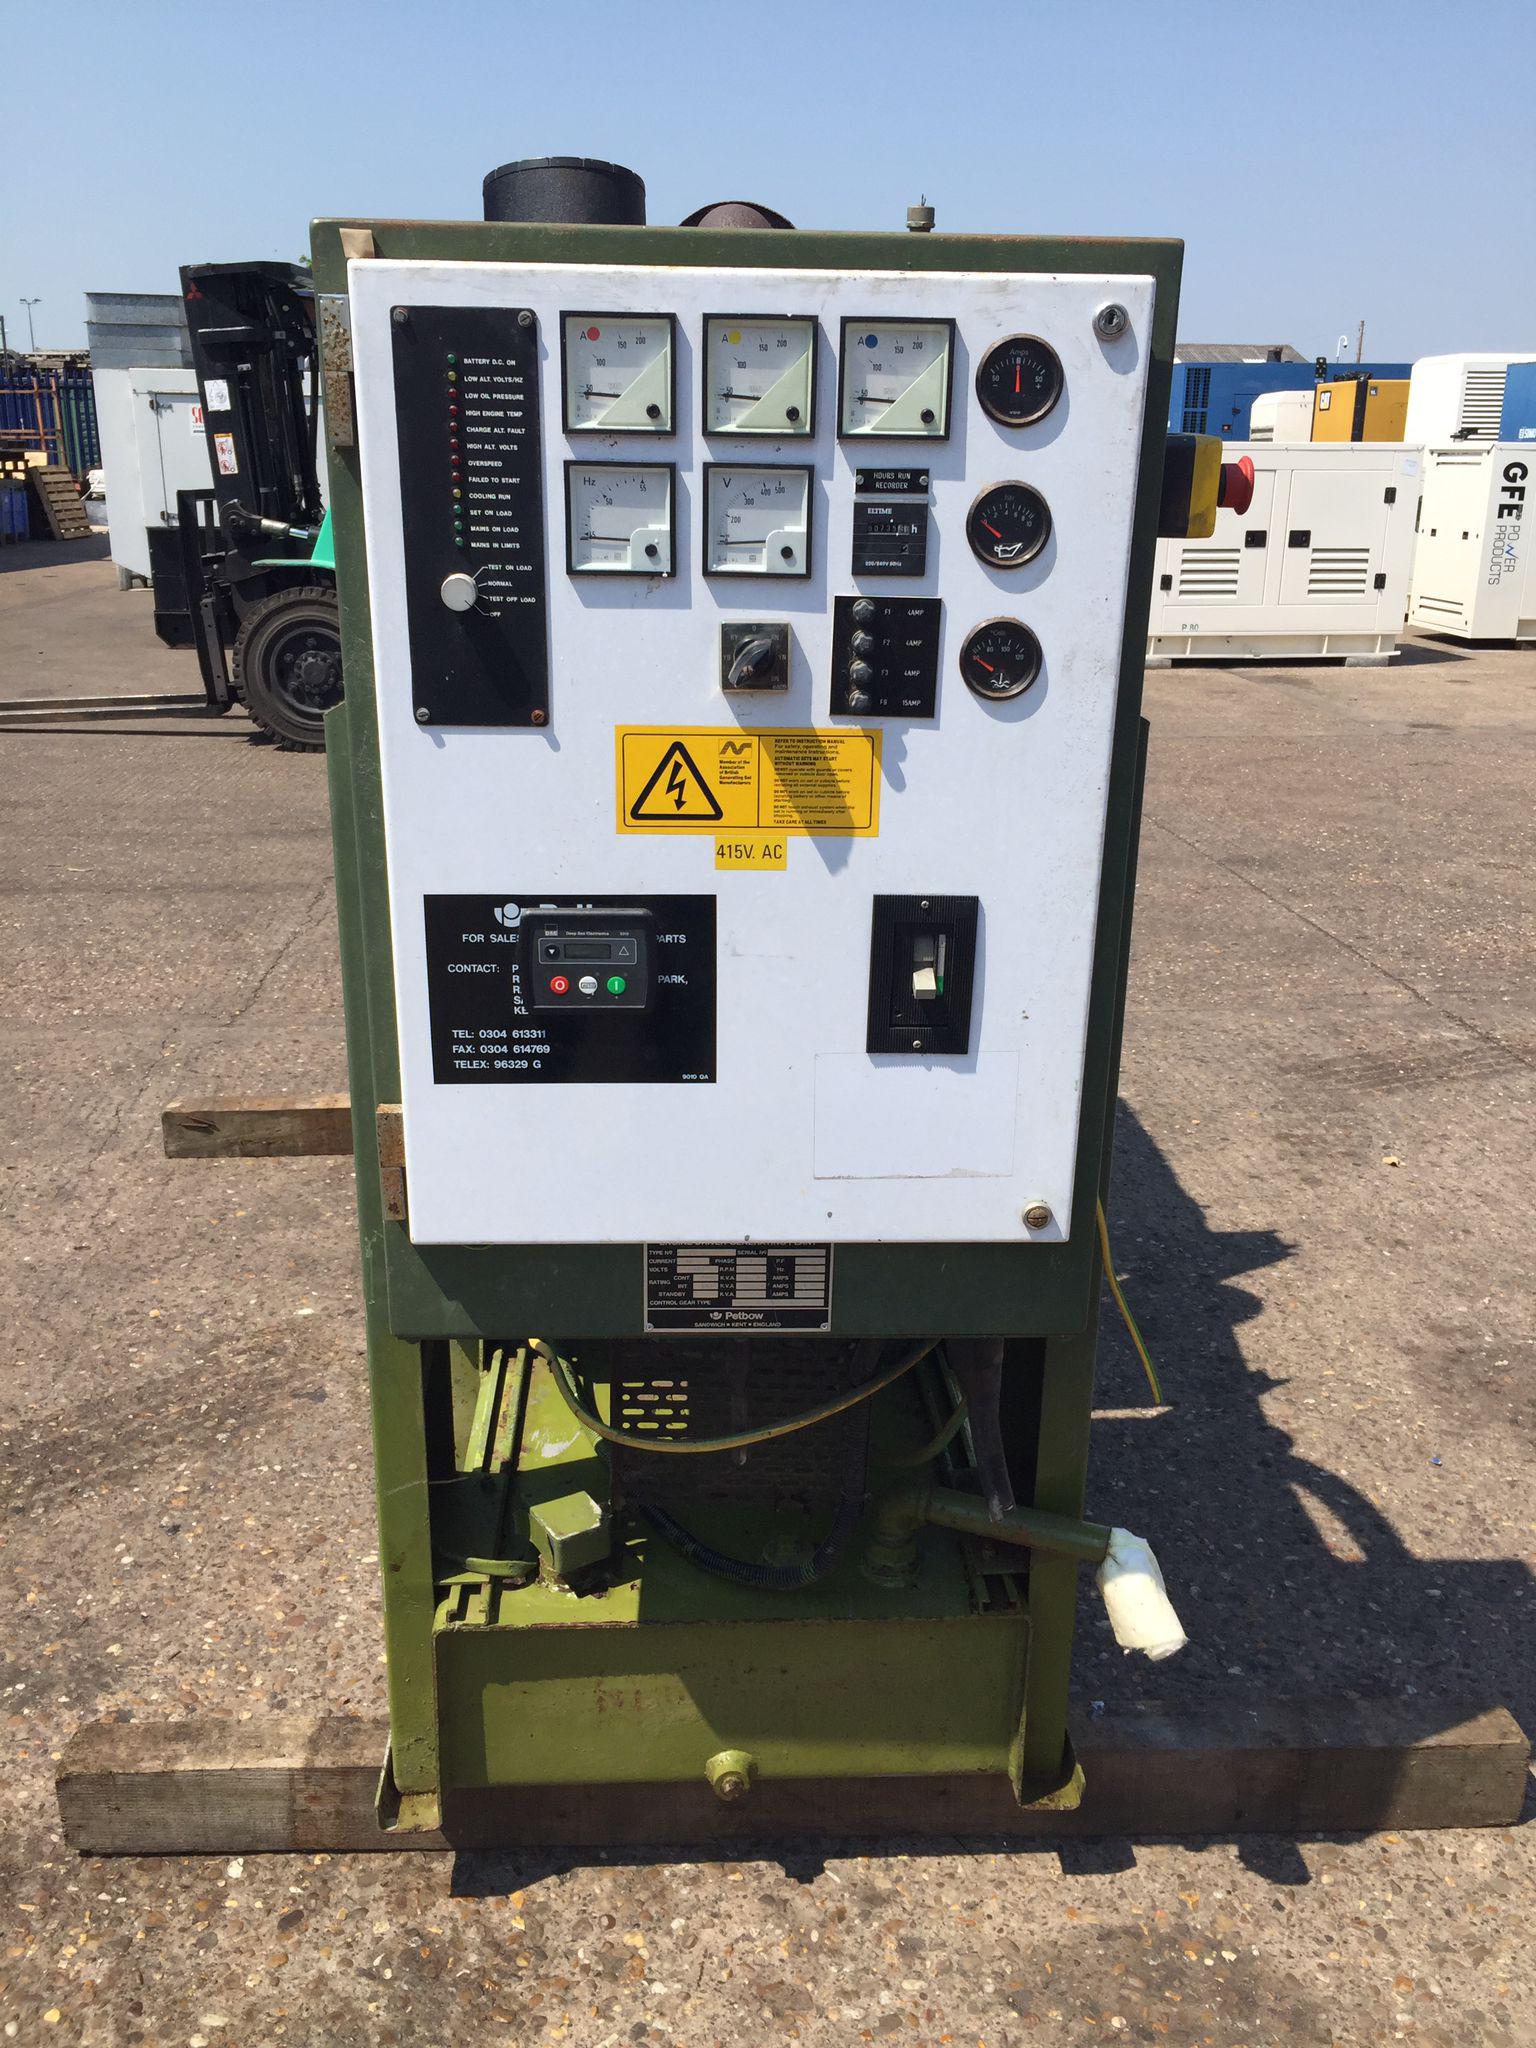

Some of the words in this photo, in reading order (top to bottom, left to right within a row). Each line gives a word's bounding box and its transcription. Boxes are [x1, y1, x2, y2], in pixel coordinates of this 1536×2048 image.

[580, 331, 587, 340] A
[722, 334, 728, 343] A
[618, 341, 626, 349] 150
[858, 336, 864, 346] A
[759, 344, 768, 352] 150
[895, 346, 903, 354] 150
[873, 363, 882, 371] 100
[586, 384, 593, 392] 50
[583, 477, 596, 486] Hz
[723, 478, 731, 488] V
[761, 488, 771, 496] 400
[1497, 462, 1528, 519] GFE
[744, 498, 754, 506] 300
[911, 524, 917, 533] h
[1488, 524, 1507, 585] PRODUCTS
[716, 844, 755, 859] 415V.
[762, 844, 783, 859] AC
[462, 934, 484, 942] FOR
[447, 964, 500, 973] CONTACT:
[658, 975, 688, 985] PARK,
[452, 1030, 474, 1038] TEL:
[479, 1030, 507, 1038] 0304
[512, 1030, 546, 1038] 613311
[453, 1045, 476, 1054] FAX:
[480, 1045, 508, 1054] 0304
[513, 1045, 550, 1054] 614769
[454, 1060, 490, 1069] TELEX:
[494, 1060, 528, 1069] 96329
[532, 1060, 541, 1069] G
[725, 1311, 763, 1320] Petbow
